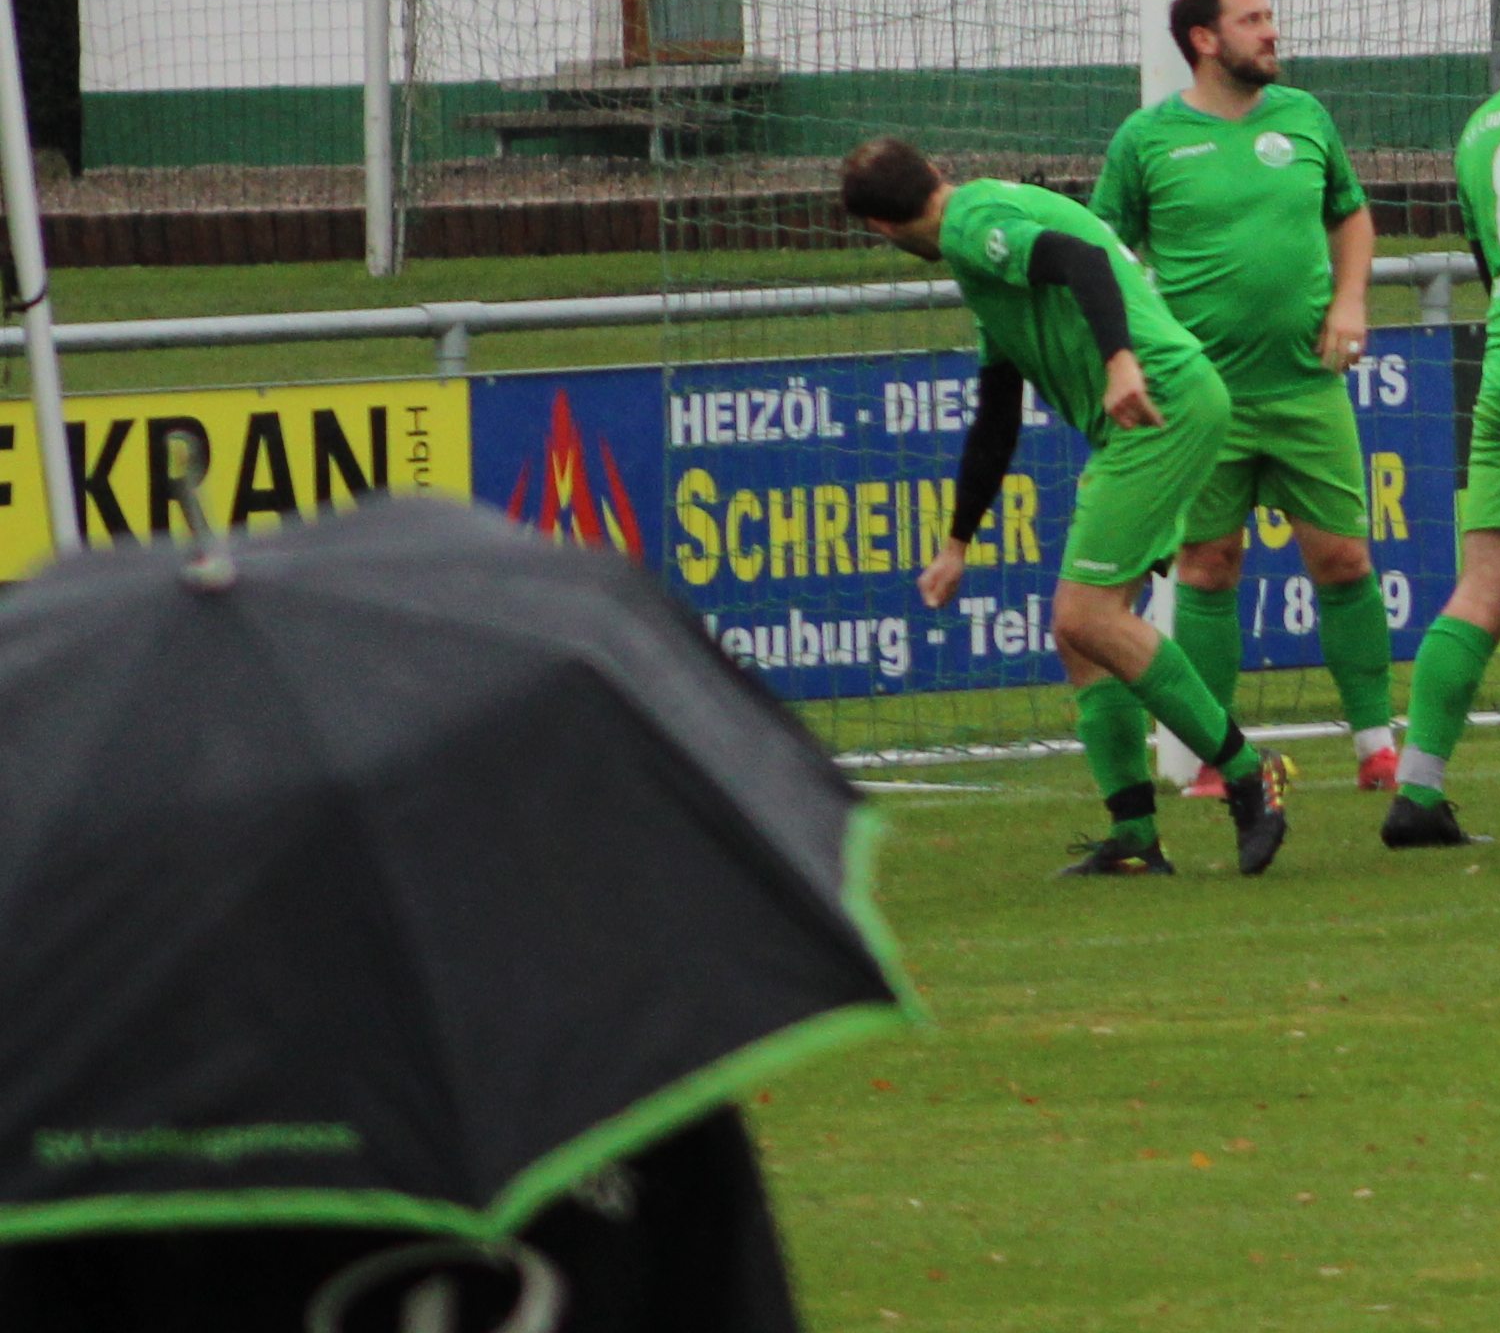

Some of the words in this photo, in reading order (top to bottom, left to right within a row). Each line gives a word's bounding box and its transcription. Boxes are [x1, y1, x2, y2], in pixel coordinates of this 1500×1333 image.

[670, 377, 845, 447] HEIZÖL
[884, 379, 1049, 434] DIESL
[703, 608, 910, 678] euburg
